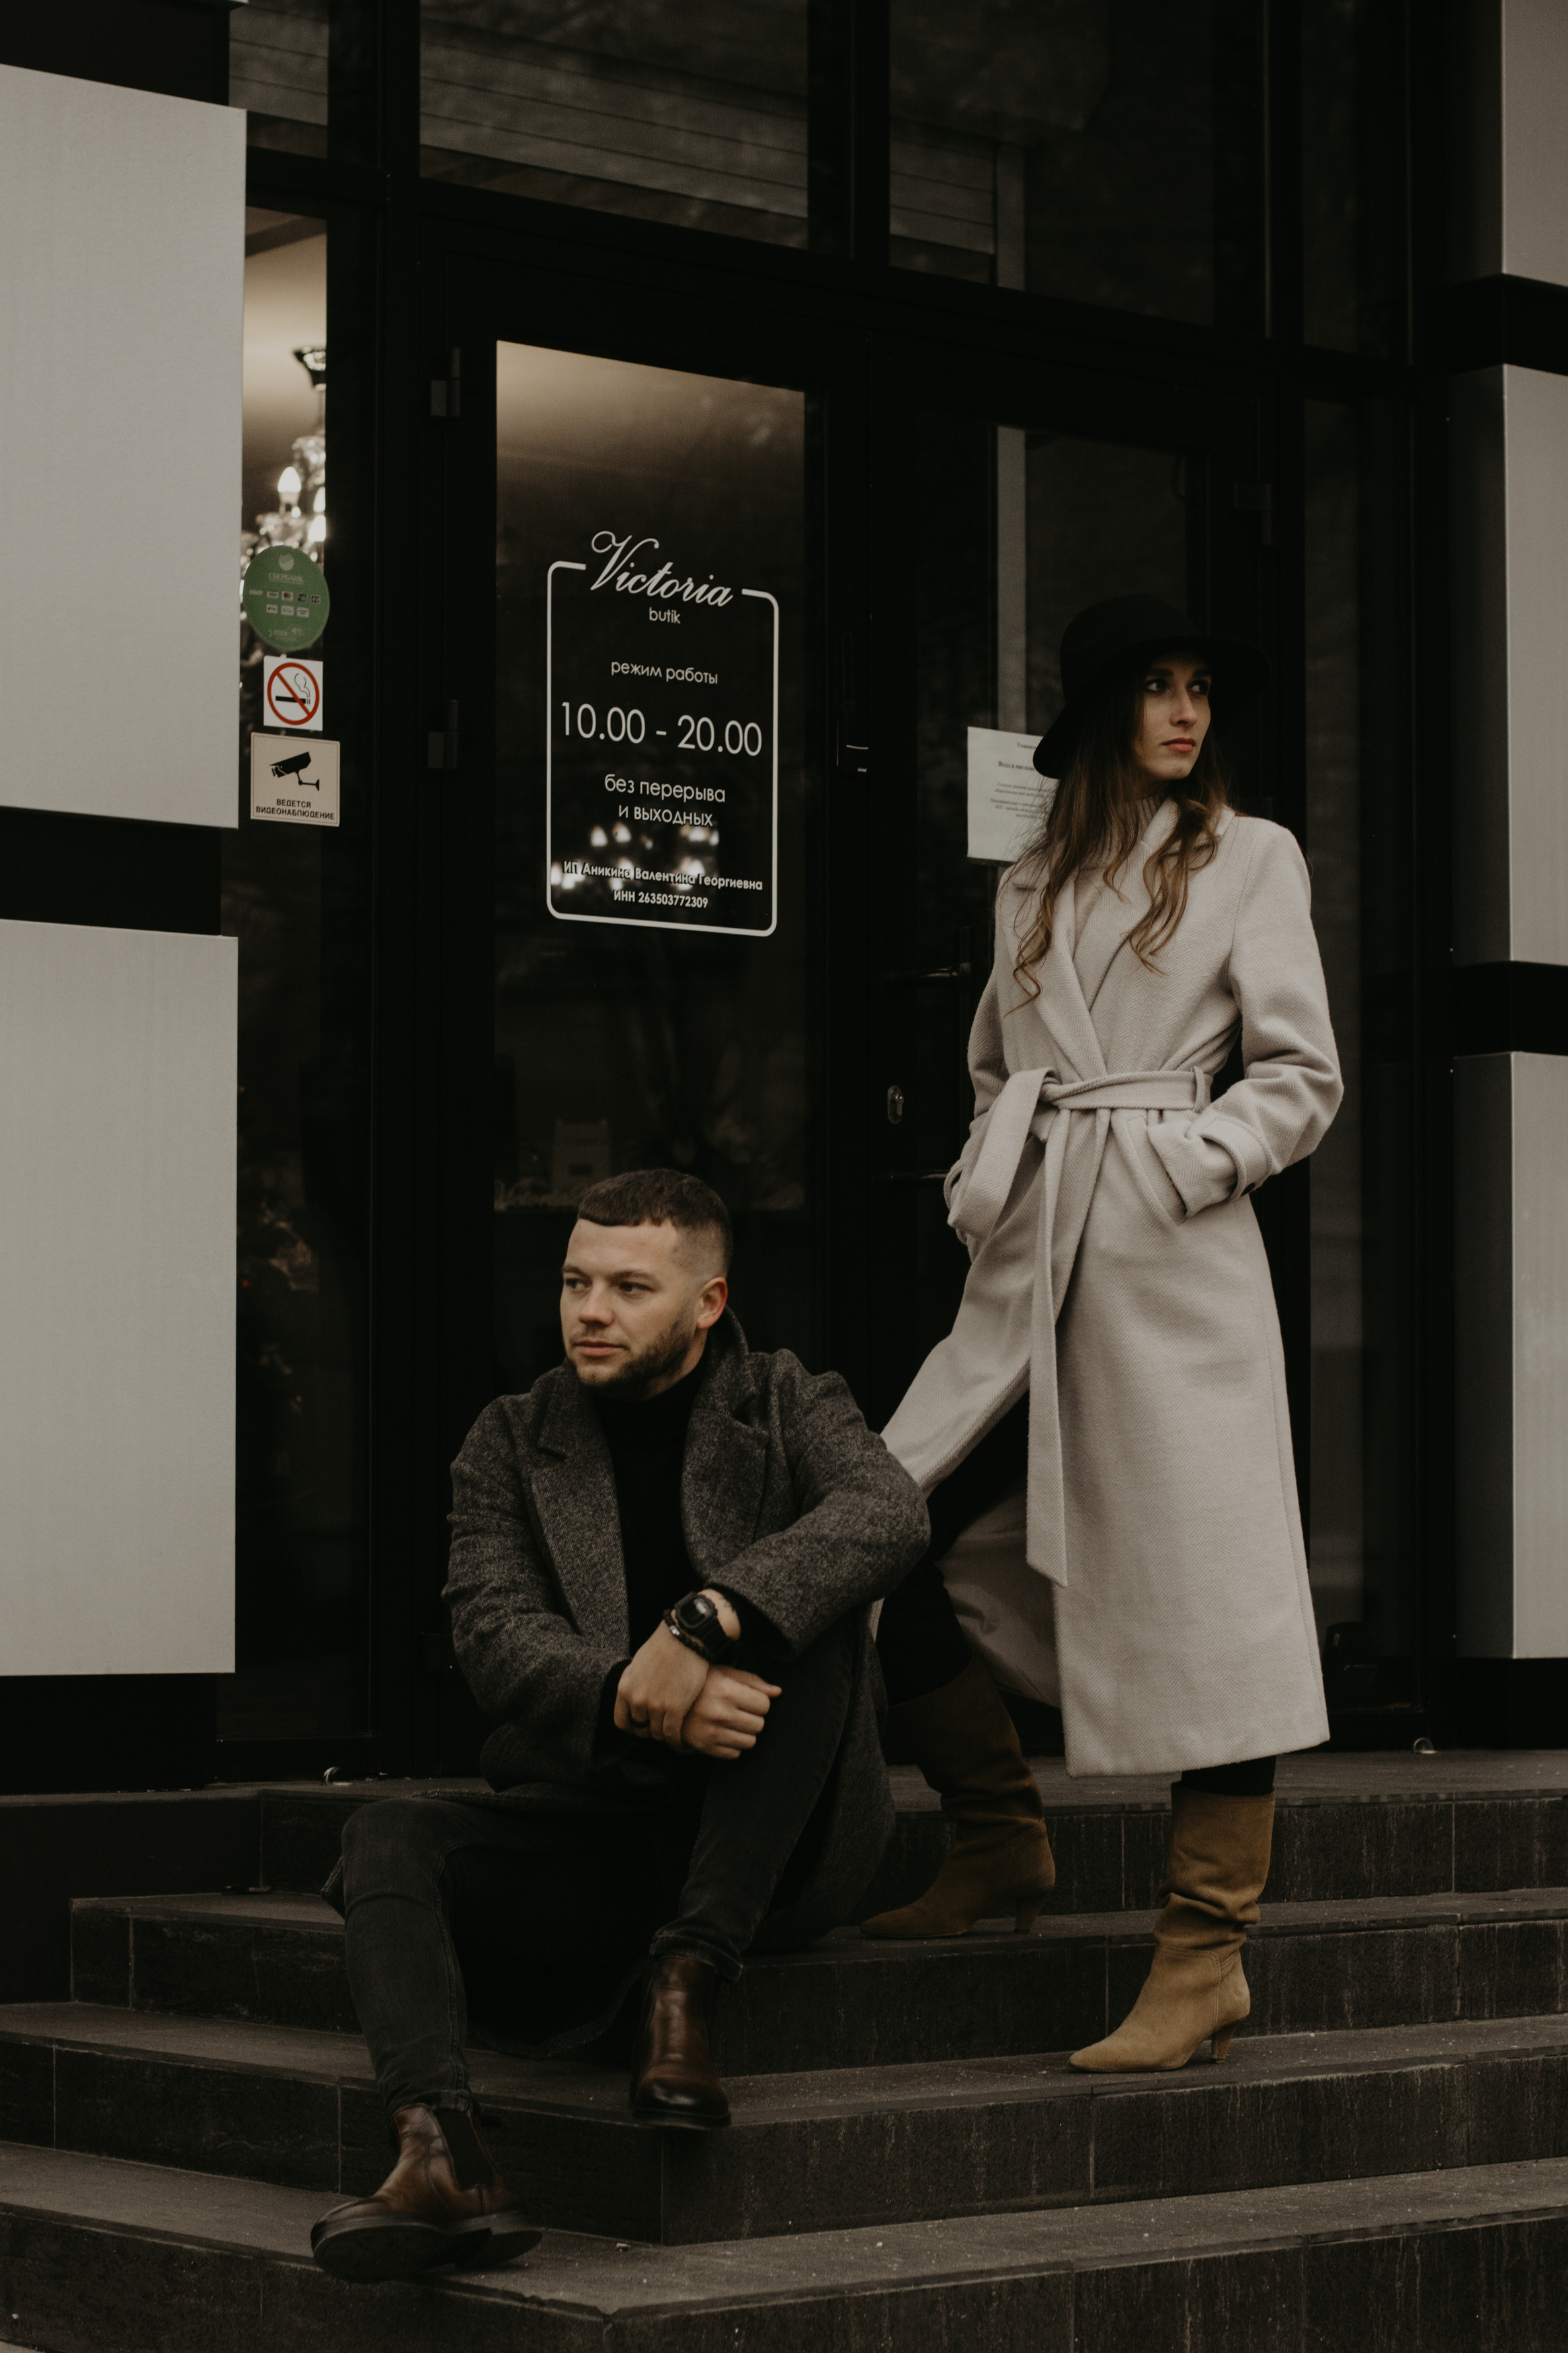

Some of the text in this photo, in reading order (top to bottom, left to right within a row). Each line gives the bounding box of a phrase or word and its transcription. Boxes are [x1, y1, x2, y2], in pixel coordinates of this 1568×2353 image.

[590, 530, 733, 608] Victoria
[649, 606, 682, 625] butik
[611, 660, 718, 684] режим работы
[561, 701, 646, 744] 10.00
[677, 714, 763, 756] 20.00
[604, 773, 726, 803] без перерыва
[256, 805, 335, 820] ВИДЕОНАБЛЮДЕНИЕ
[276, 799, 312, 809] ВЕДЕТСЯ
[618, 805, 713, 826] и выходных
[564, 861, 764, 891] ИП Аникина Валентина Георгиевна
[614, 889, 709, 908] ИНН 263503772309
